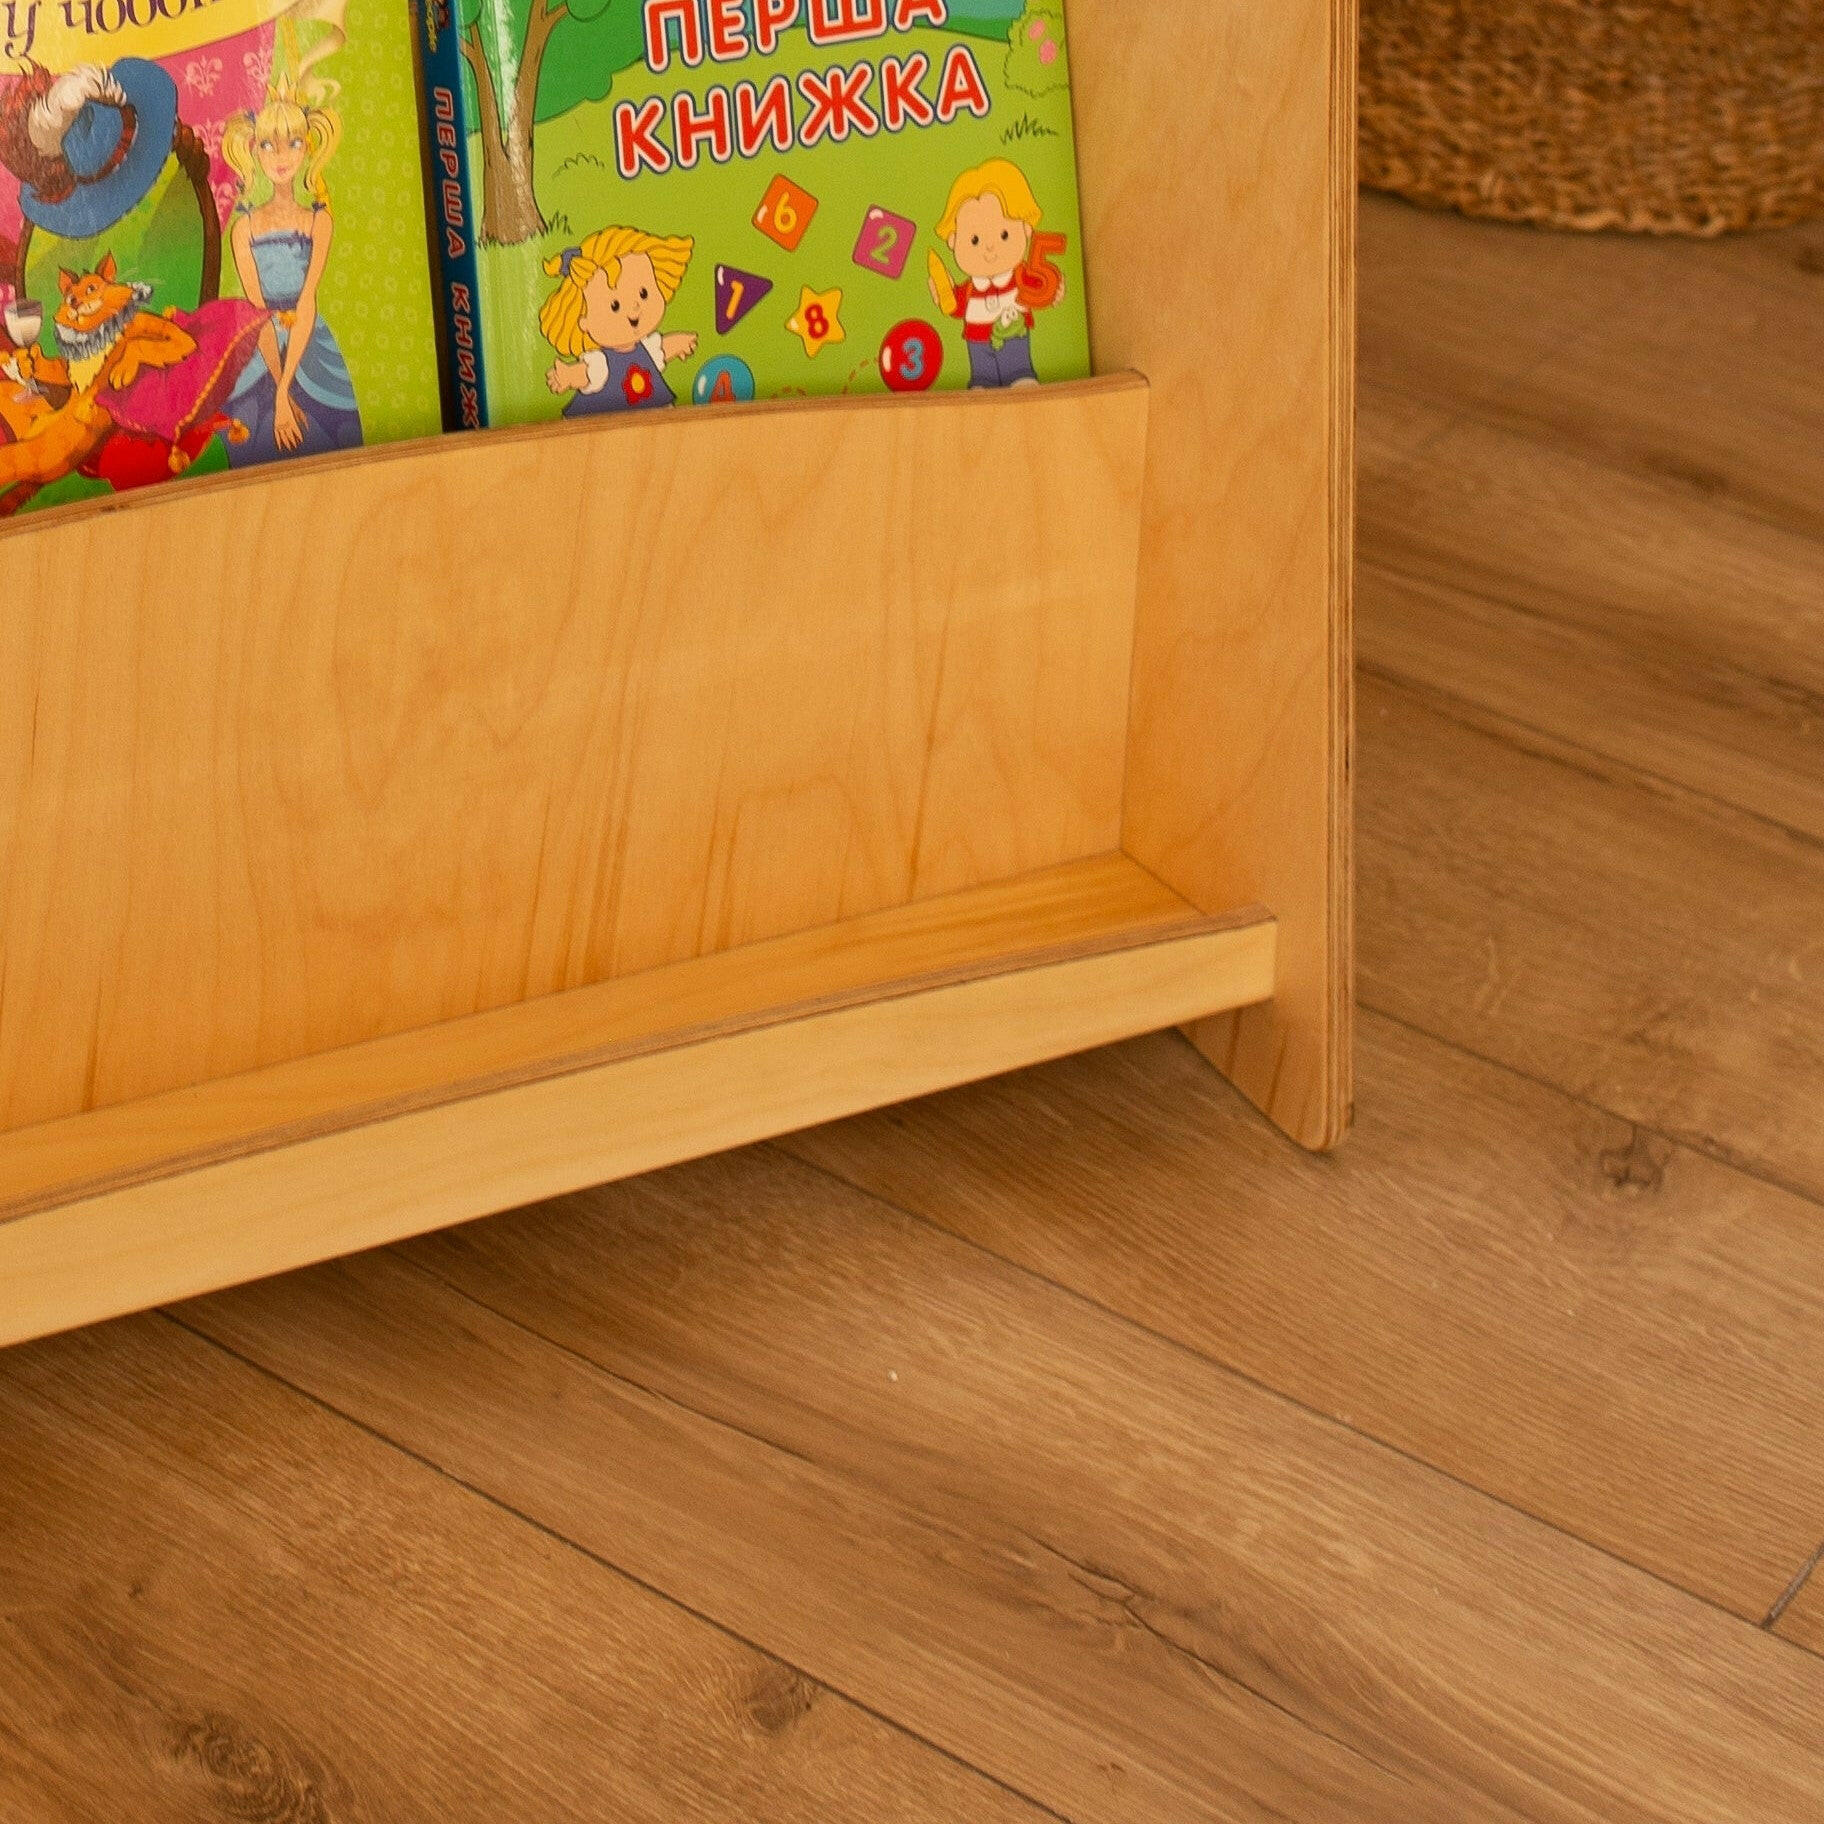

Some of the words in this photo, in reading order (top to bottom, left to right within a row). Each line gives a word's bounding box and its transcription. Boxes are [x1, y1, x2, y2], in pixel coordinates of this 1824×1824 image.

[612, 45, 992, 181] КНИЖКА
[433, 85, 467, 260] ПЕРША
[774, 191, 798, 234] 6
[869, 225, 900, 265] 2
[1014, 230, 1067, 310] 5
[803, 302, 830, 340] 8
[900, 336, 925, 381] 3
